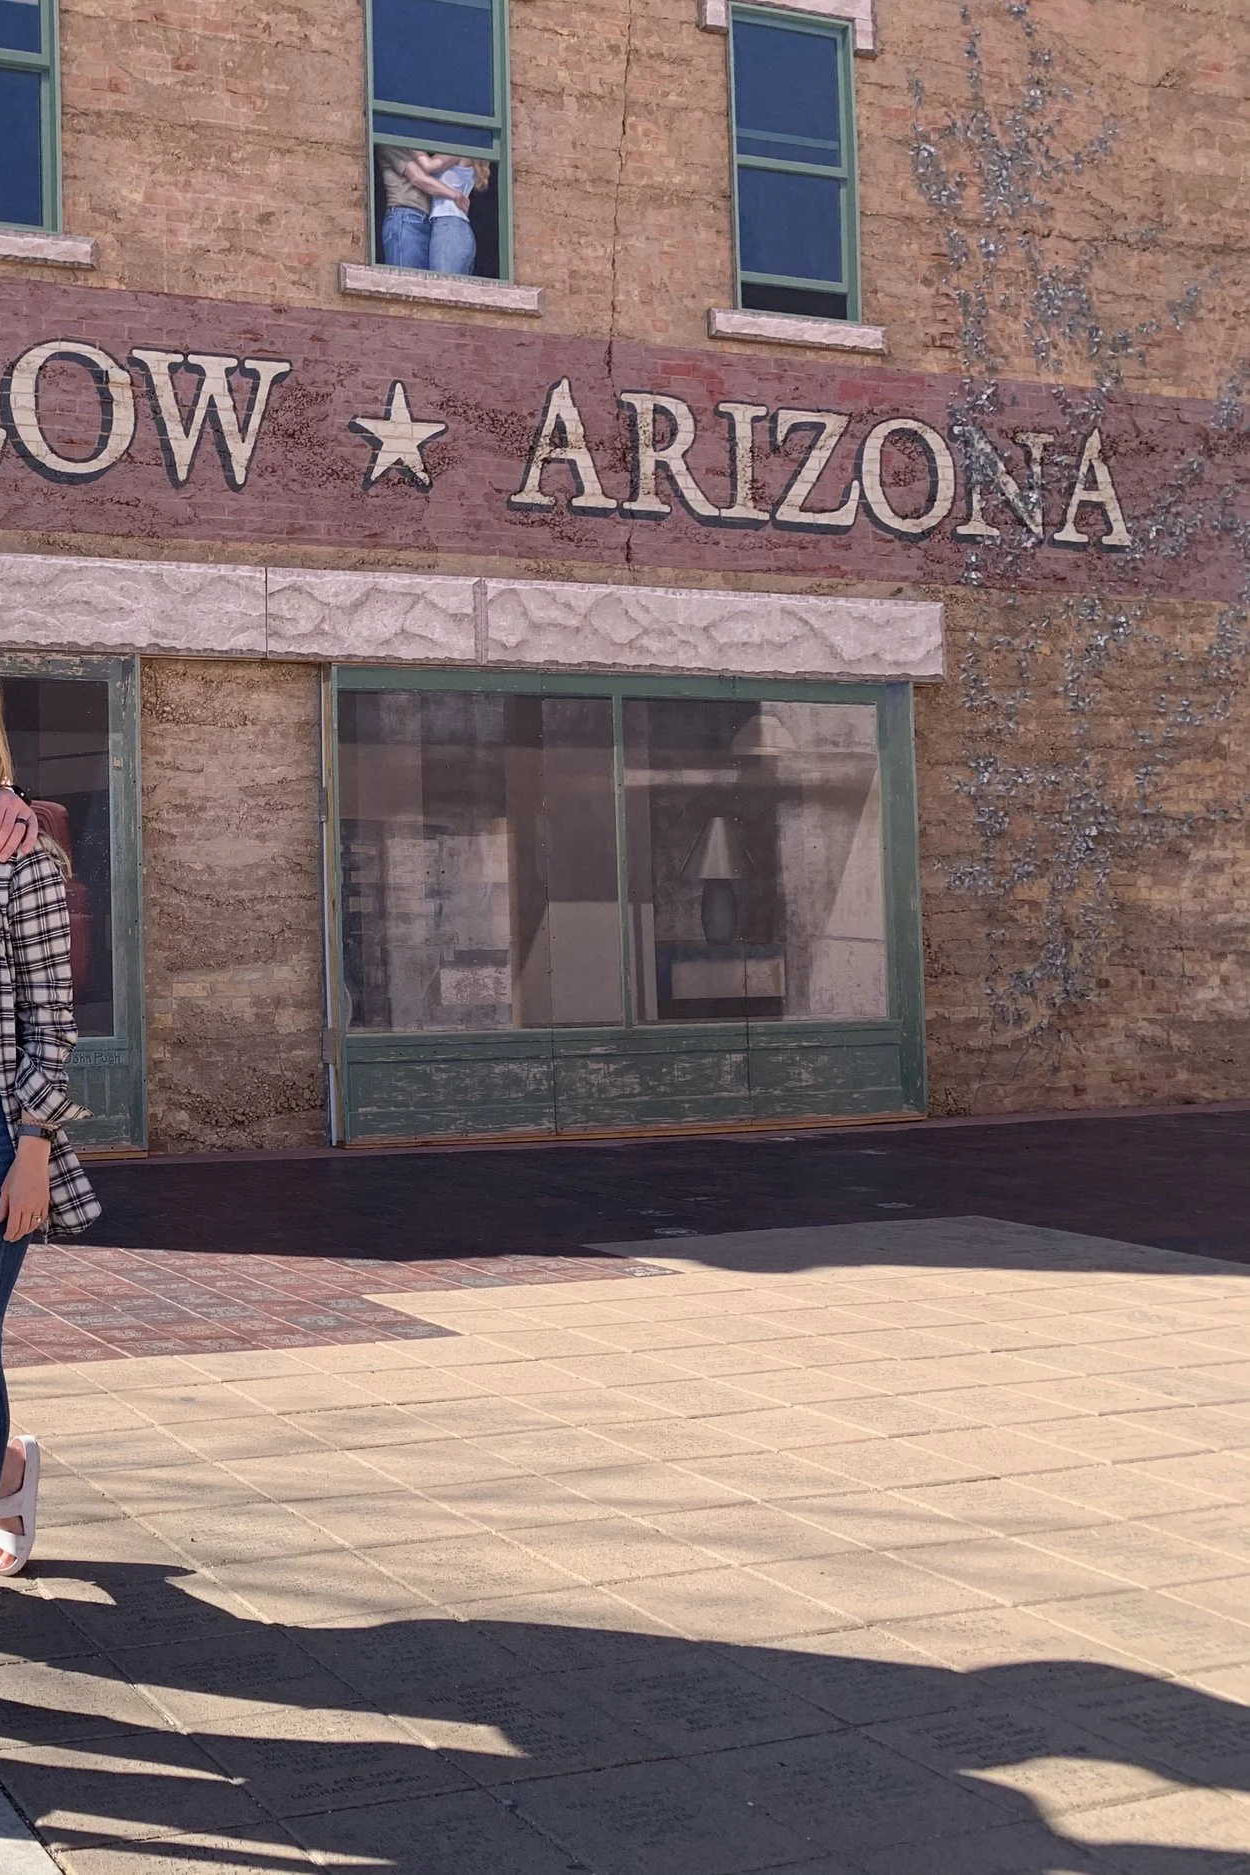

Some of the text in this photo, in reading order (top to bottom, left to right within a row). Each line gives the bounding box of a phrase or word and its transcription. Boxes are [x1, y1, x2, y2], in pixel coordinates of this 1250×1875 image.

[507, 374, 1133, 554] ARIZONA
[63, 1052, 121, 1065] John Pugh
